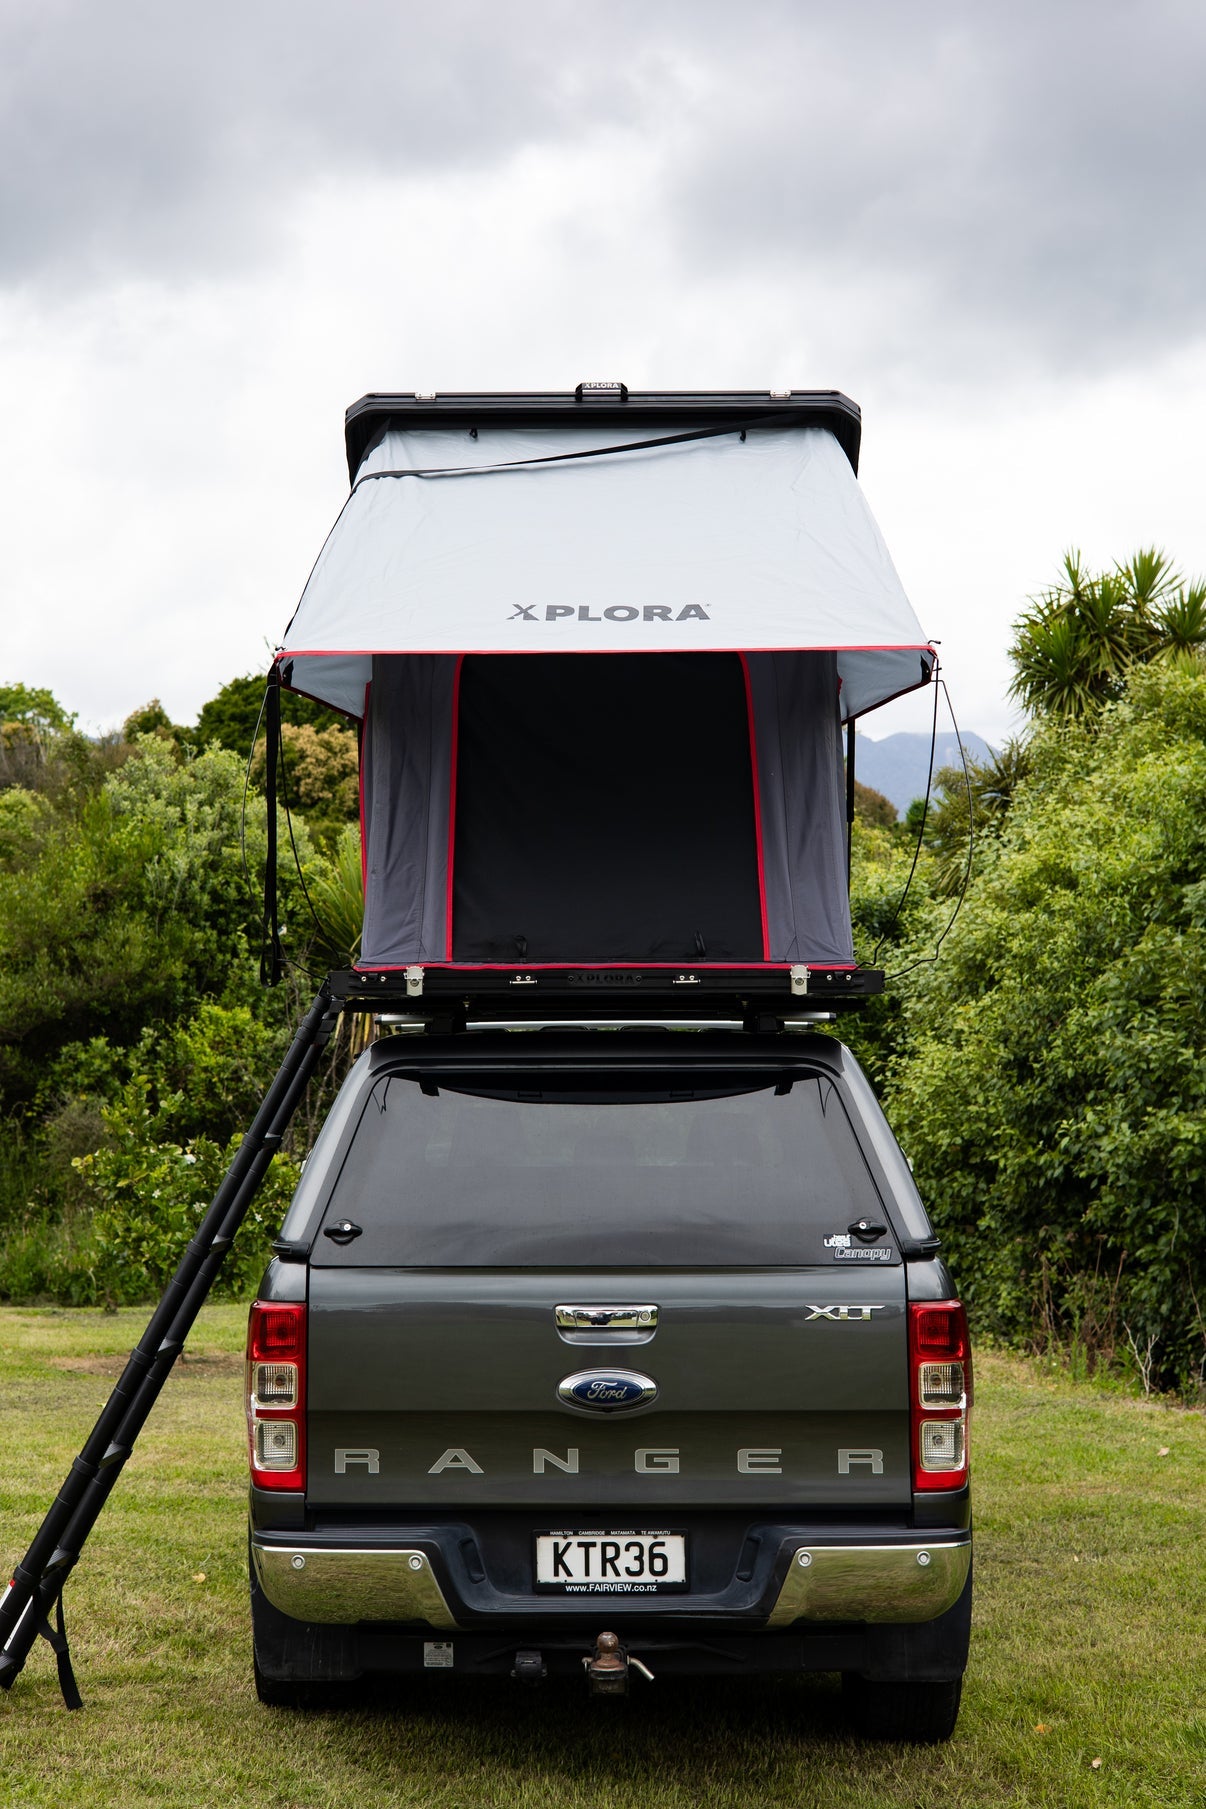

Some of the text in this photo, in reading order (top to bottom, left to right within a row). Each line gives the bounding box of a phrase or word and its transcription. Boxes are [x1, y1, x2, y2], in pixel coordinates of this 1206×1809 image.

[506, 604, 711, 621] XPLORA
[835, 1247, 891, 1260] Canopy
[804, 1305, 886, 1320] XLT
[587, 1381, 628, 1399] Ford
[334, 1448, 884, 1474] RANGER
[553, 1541, 669, 1577] KTR36
[565, 1583, 657, 1592] www.FAIRVIEW.co.nz
